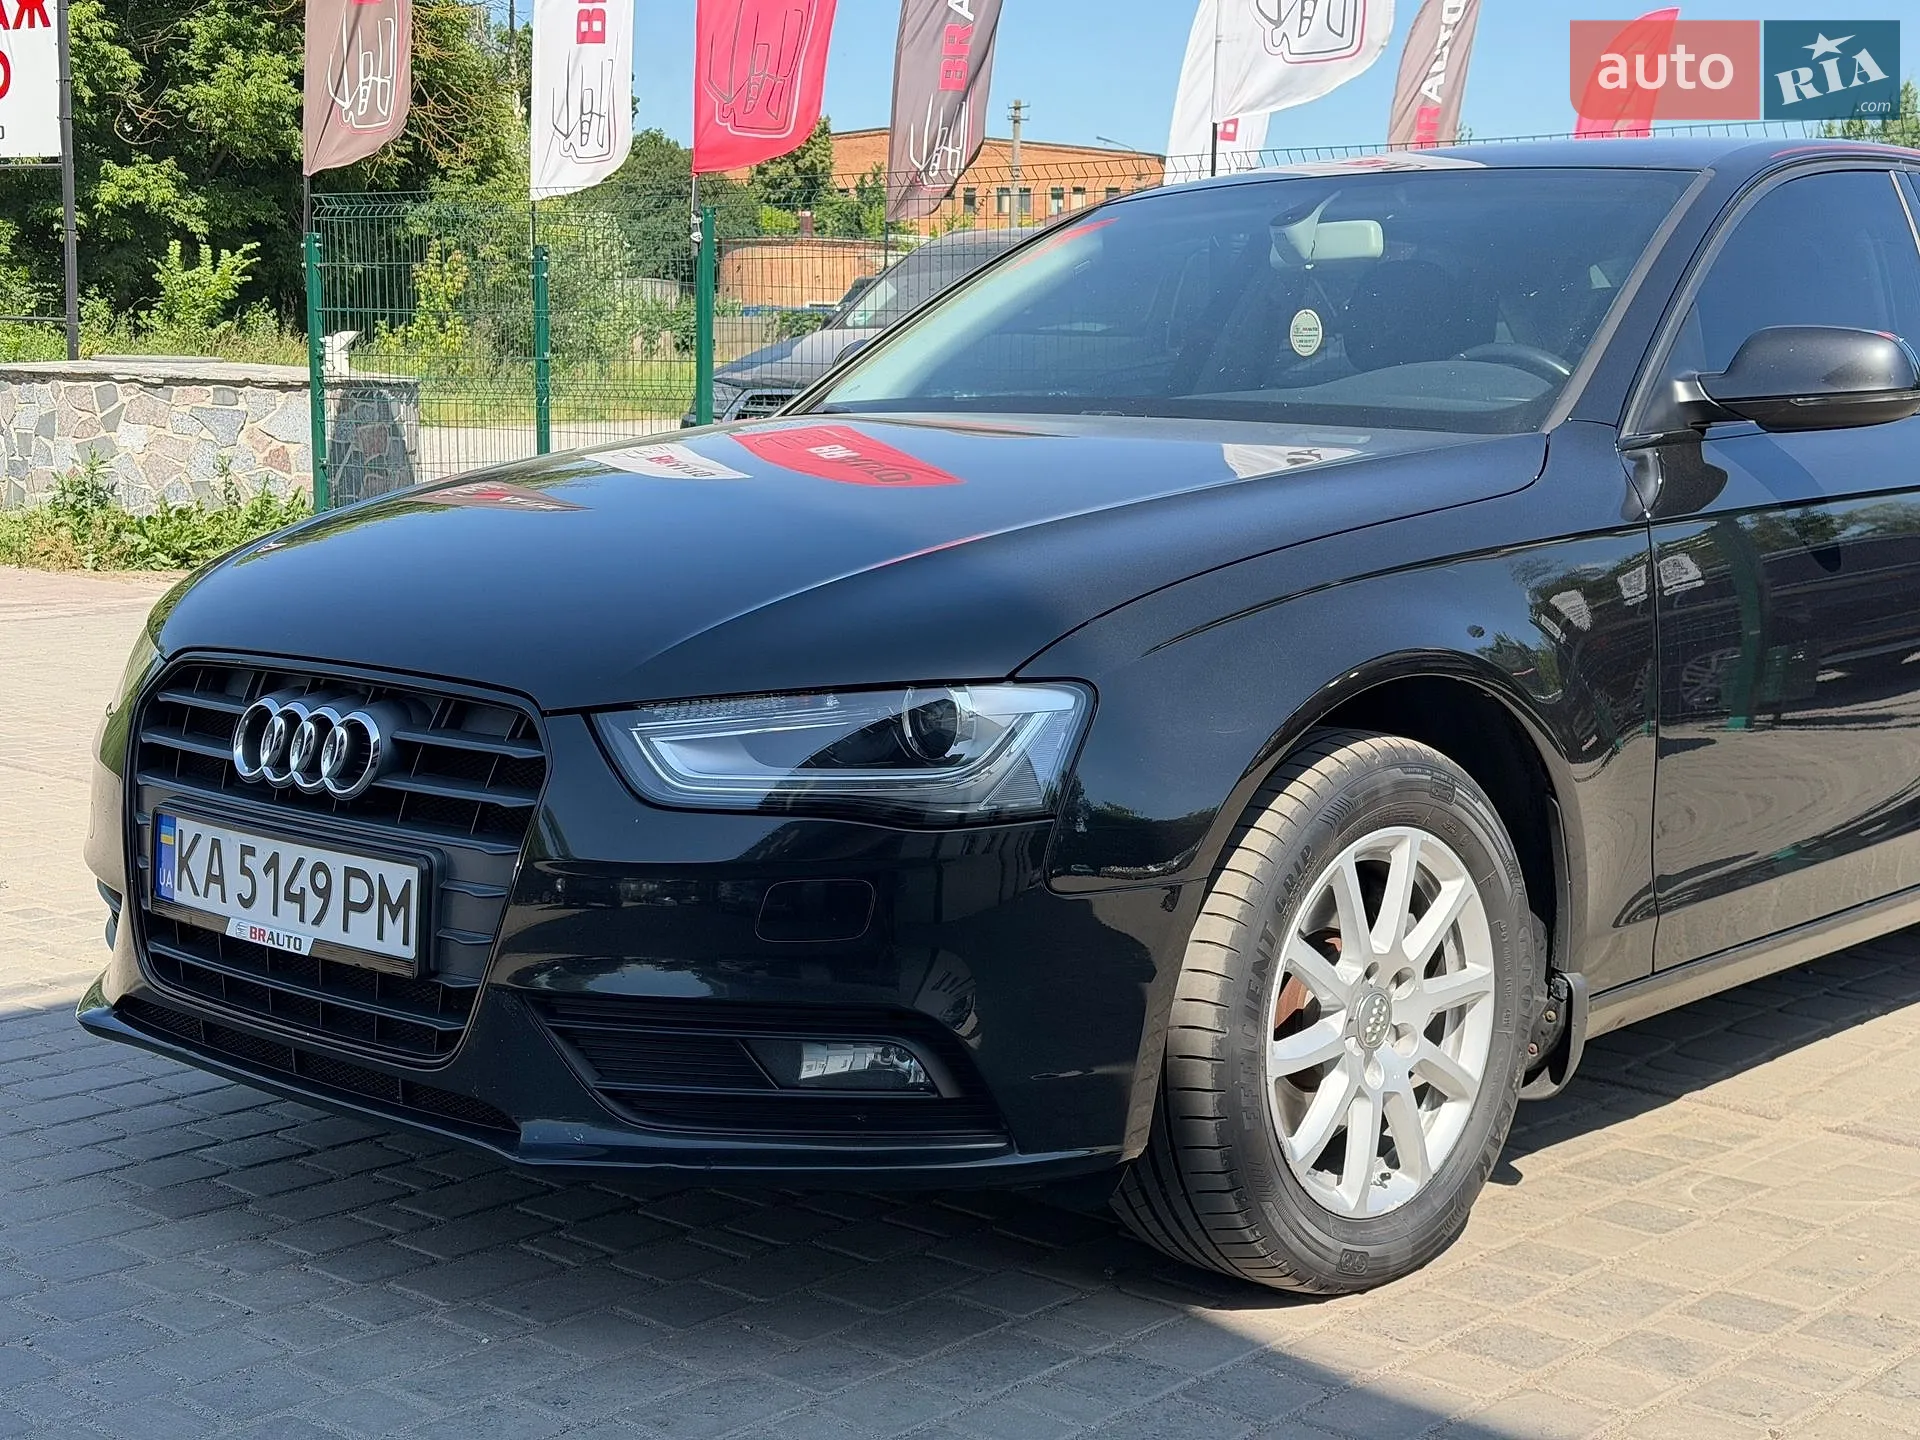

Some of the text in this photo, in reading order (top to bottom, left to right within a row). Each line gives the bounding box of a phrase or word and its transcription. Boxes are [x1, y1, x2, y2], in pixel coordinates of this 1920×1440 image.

[158, 867, 174, 889] UA
[176, 828, 412, 947] KA 5149 PM
[249, 926, 304, 952] BRAUTO
